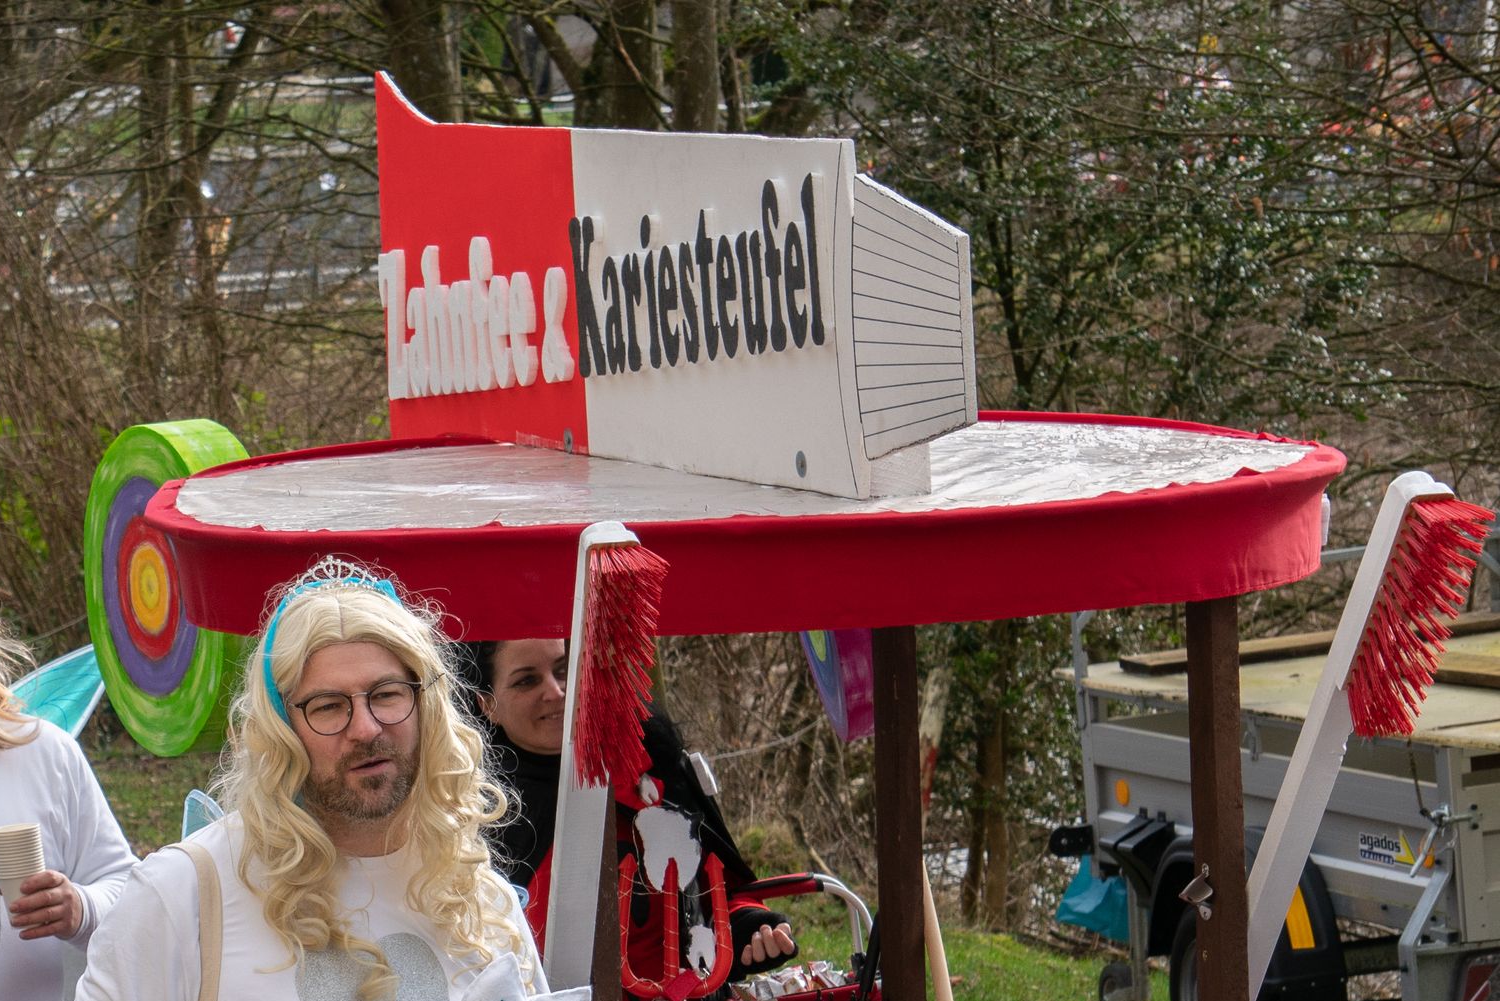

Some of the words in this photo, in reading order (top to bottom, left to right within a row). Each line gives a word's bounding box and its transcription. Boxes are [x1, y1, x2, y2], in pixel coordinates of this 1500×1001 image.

[378, 236, 539, 399] Zahnfee
[542, 266, 575, 384] &
[569, 172, 827, 379] Kariesteufel
[1360, 833, 1401, 853] agados
